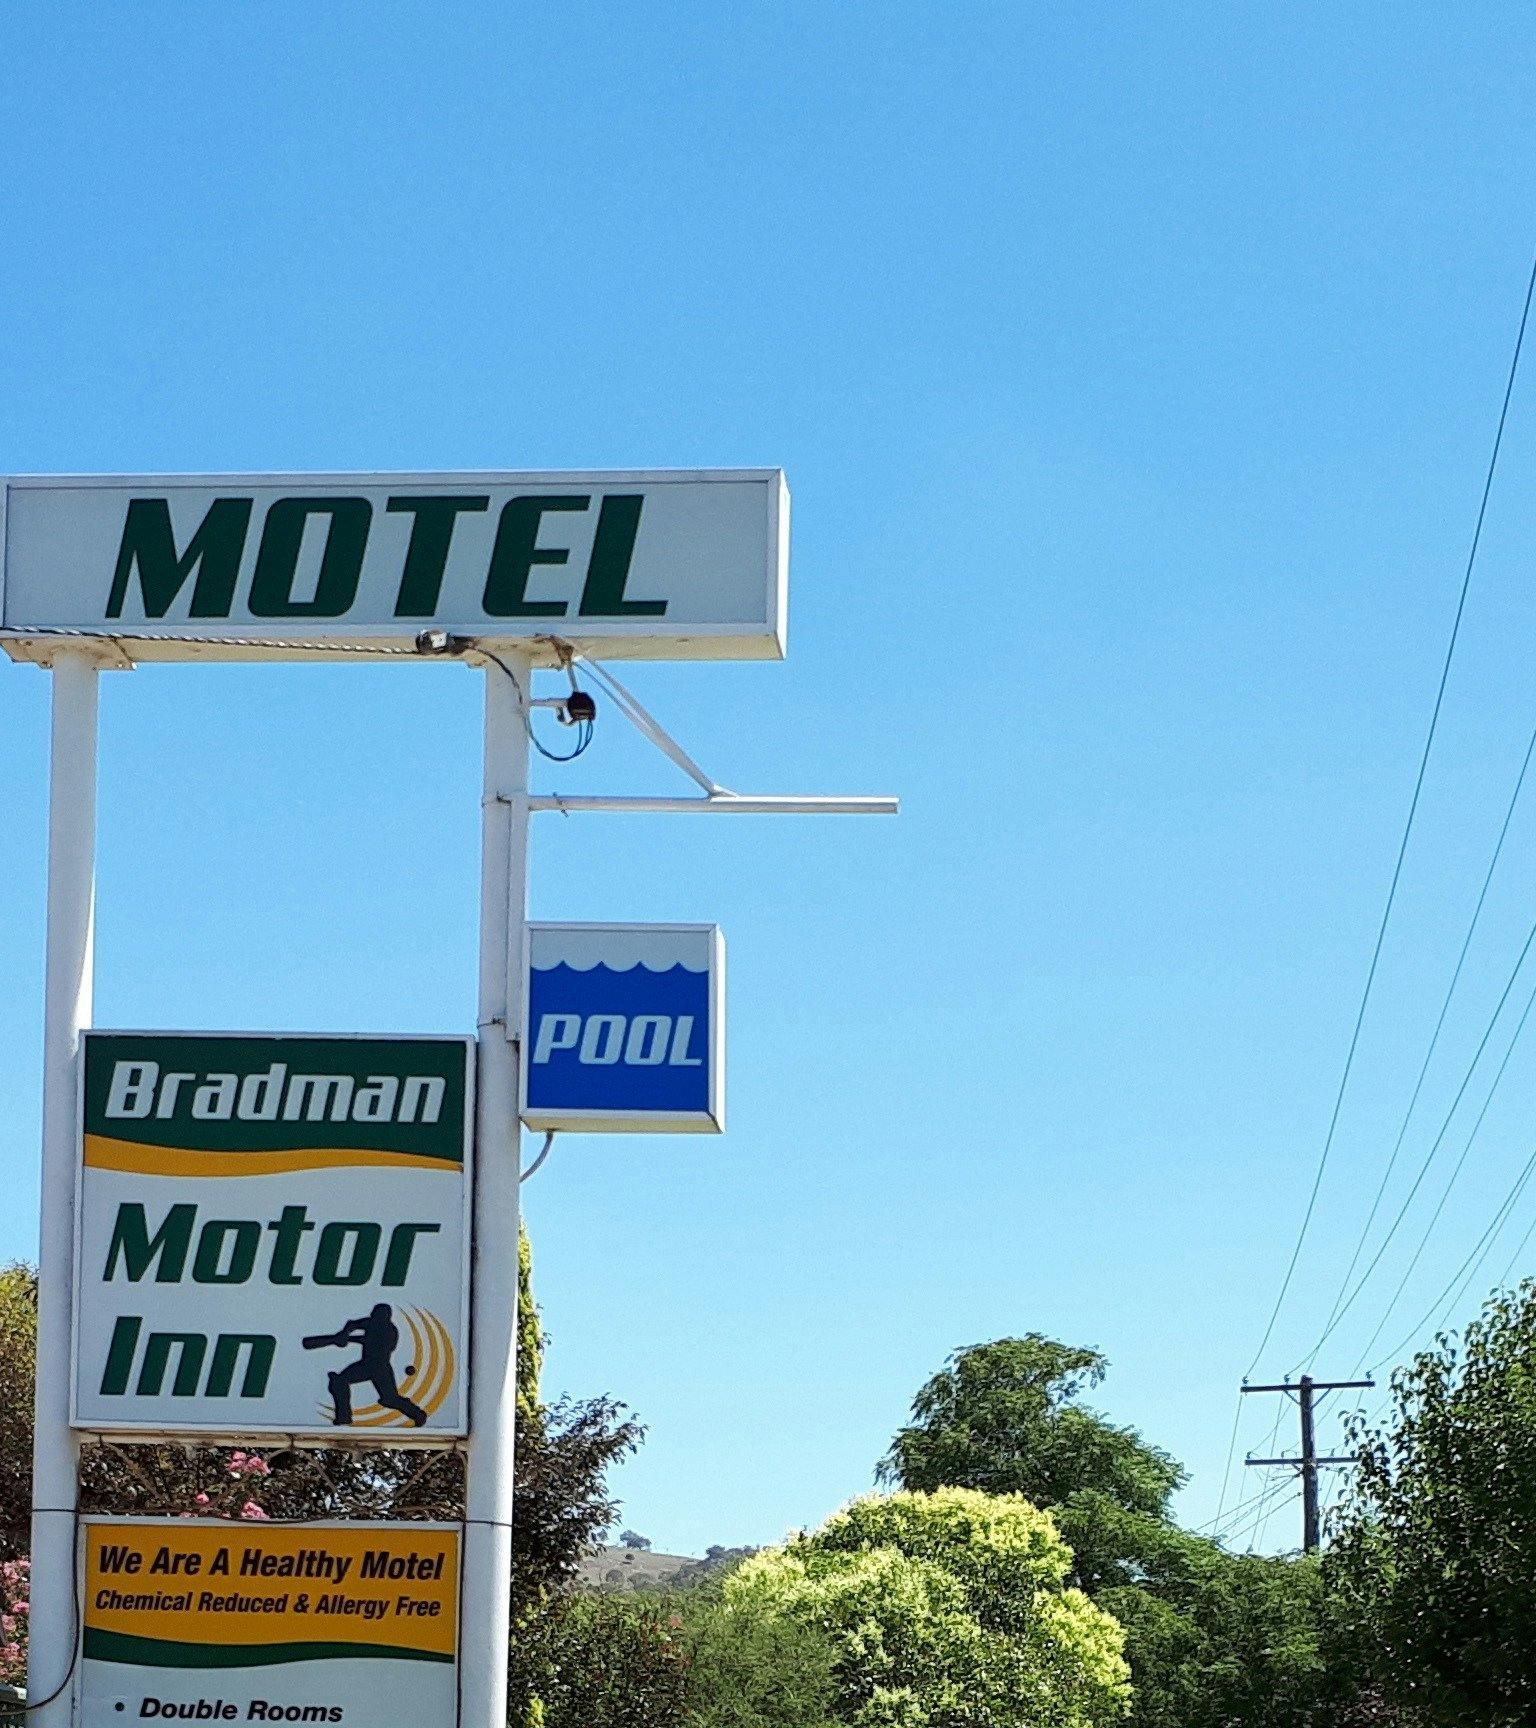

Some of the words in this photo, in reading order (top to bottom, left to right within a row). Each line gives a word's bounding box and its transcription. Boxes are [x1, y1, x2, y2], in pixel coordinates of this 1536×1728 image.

[105, 494, 669, 618] MOTEL
[533, 1014, 702, 1066] POOL
[105, 1061, 445, 1123] Bradman
[103, 1203, 441, 1287] Motor
[100, 1316, 276, 1398] Inn
[99, 1545, 142, 1573] We
[150, 1547, 200, 1575] Are
[209, 1549, 231, 1575] A
[240, 1549, 351, 1583] Healthy
[360, 1552, 444, 1580] Motel
[95, 1590, 191, 1611] Chemical
[198, 1592, 288, 1614] Reduced
[294, 1594, 310, 1613] &
[315, 1594, 388, 1620] Allergy
[395, 1596, 441, 1616] Free
[140, 1698, 238, 1720] Double
[247, 1701, 343, 1723] Rooms
